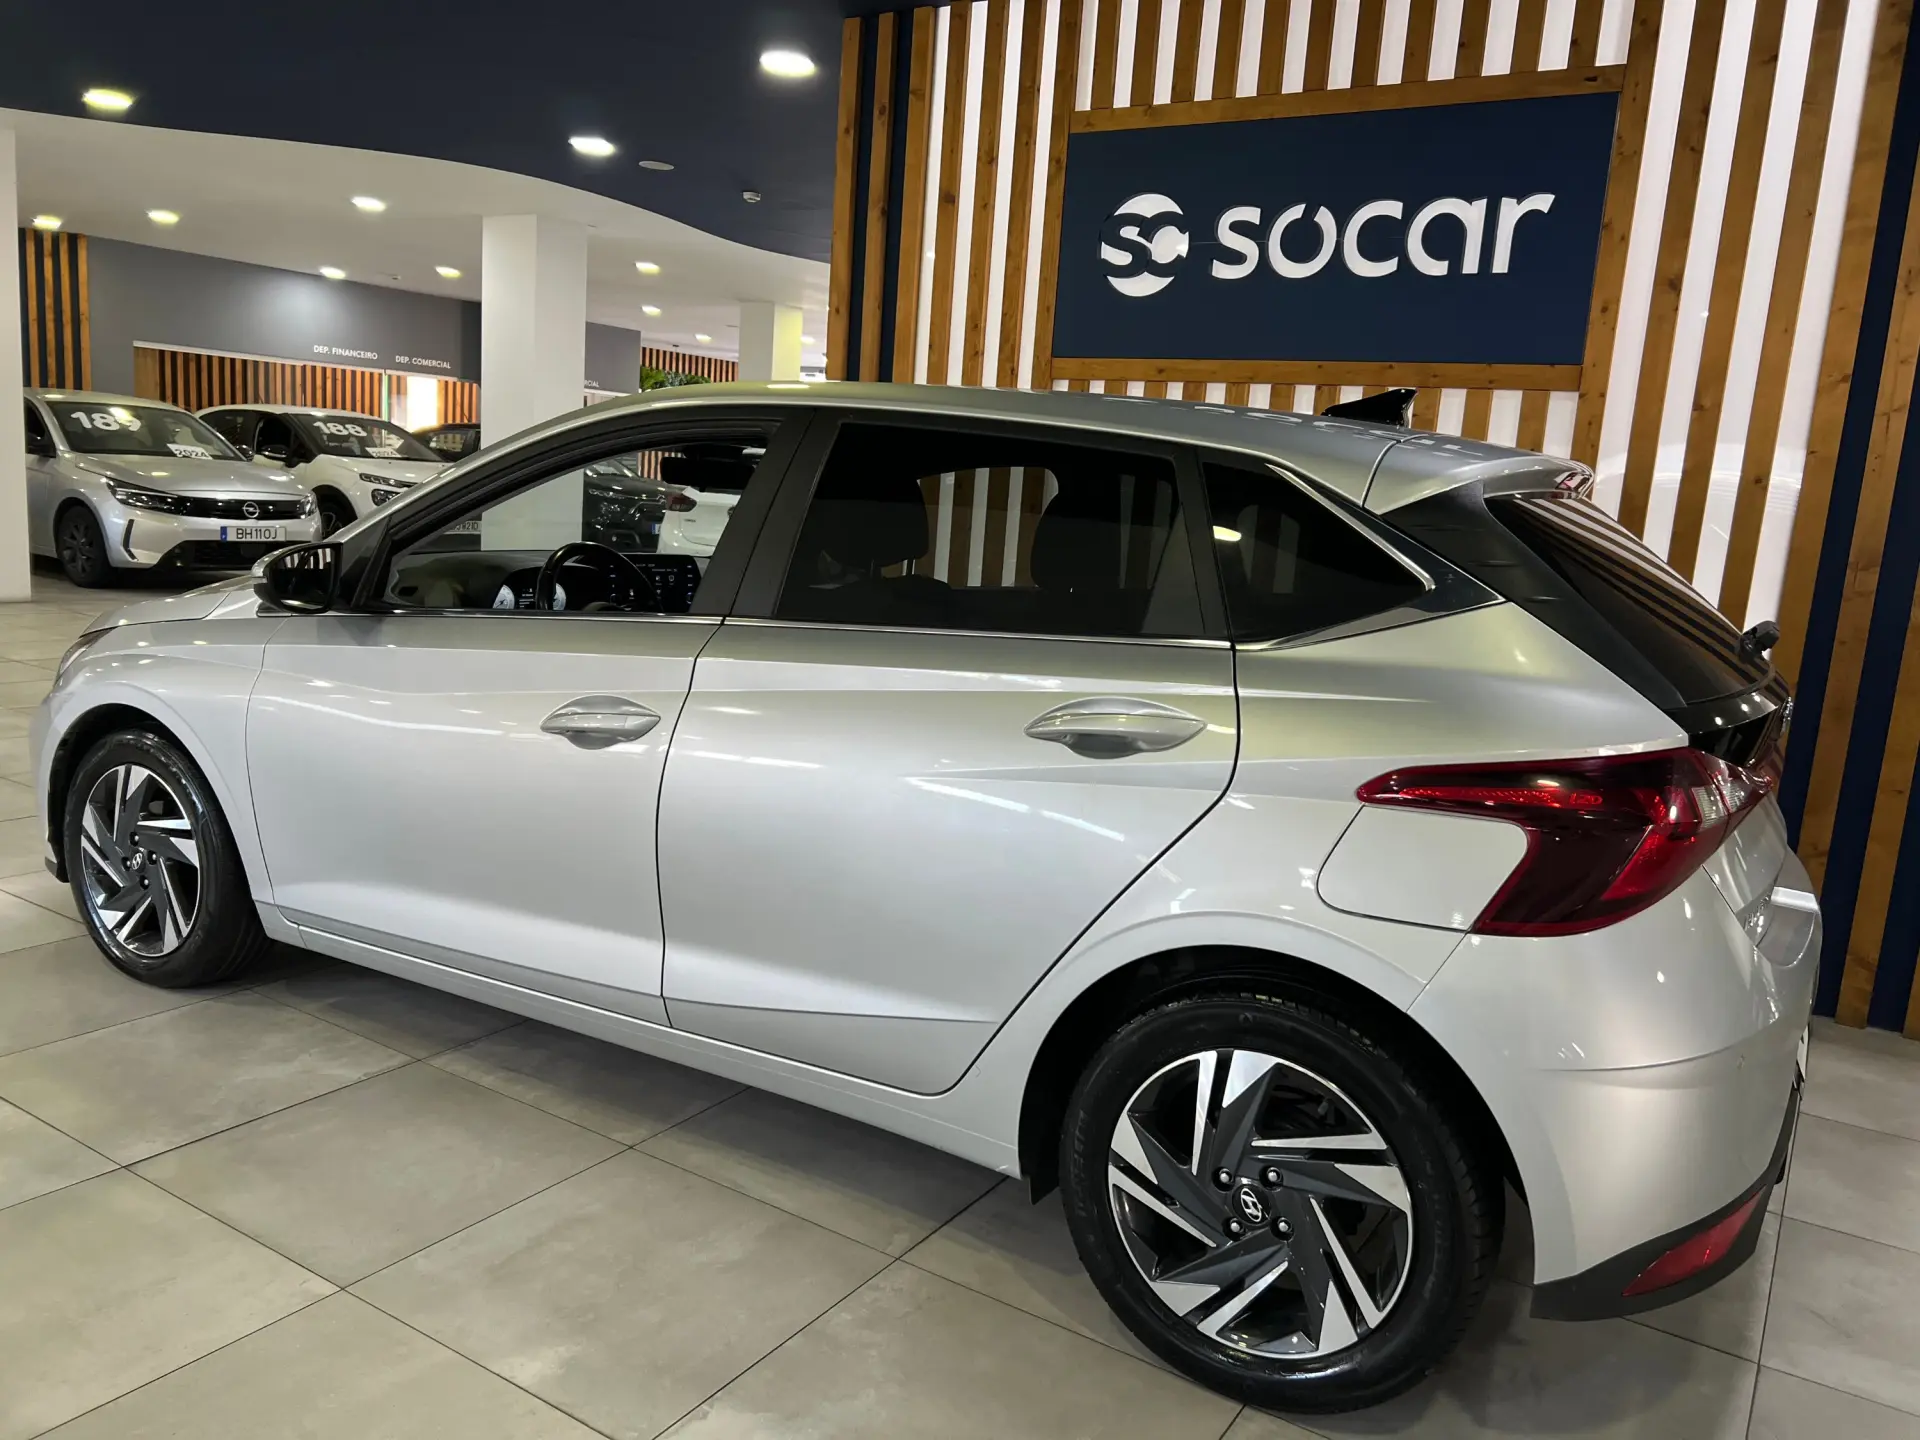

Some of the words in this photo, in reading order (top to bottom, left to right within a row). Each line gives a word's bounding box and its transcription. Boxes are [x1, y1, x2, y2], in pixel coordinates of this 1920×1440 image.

[1210, 192, 1556, 280] socar
[313, 344, 330, 355] DEP.
[332, 347, 378, 360] FINANCEIRO
[395, 355, 411, 364] DEP.
[412, 357, 452, 369] COMERCIAL
[313, 421, 368, 437] 188
